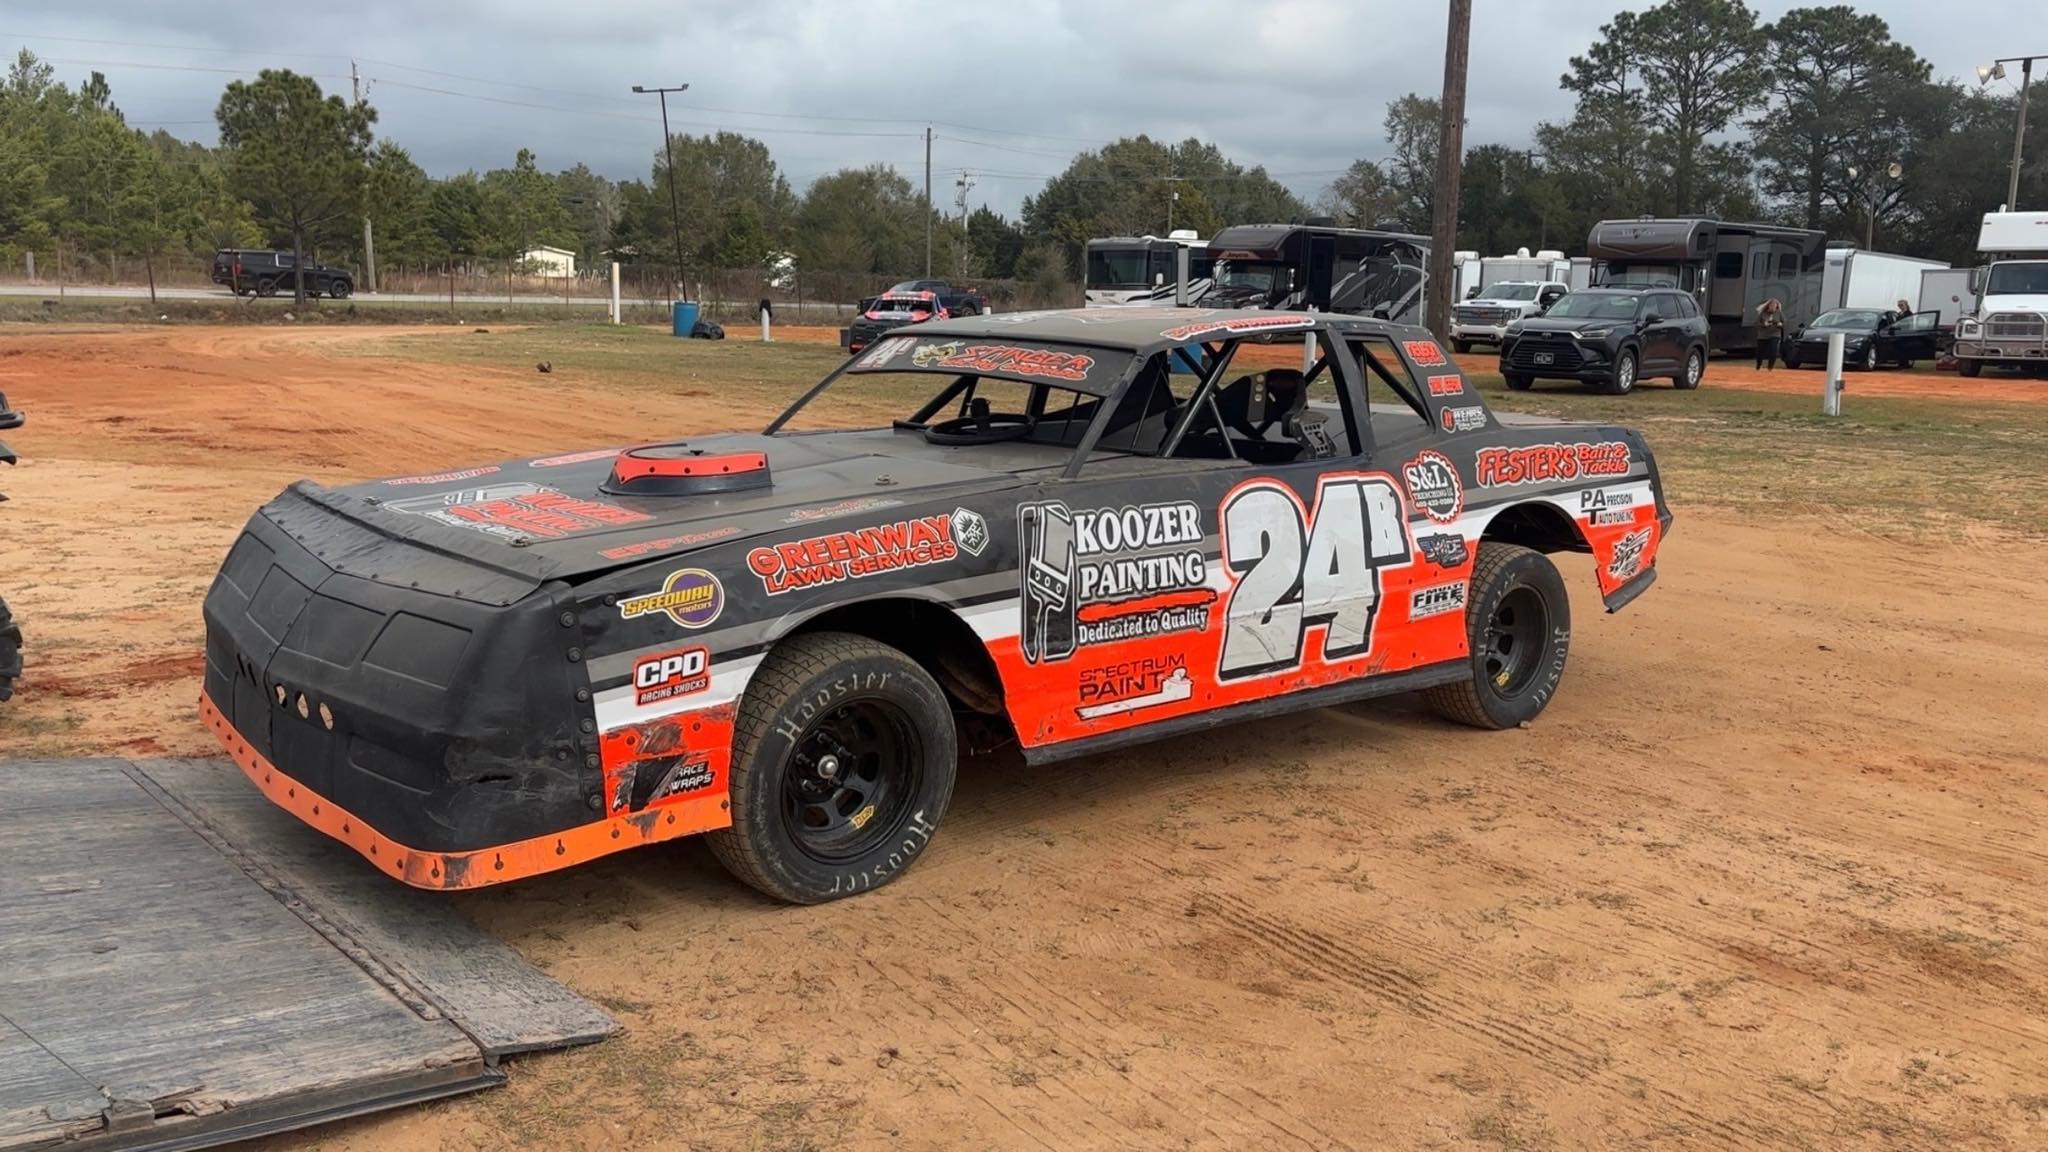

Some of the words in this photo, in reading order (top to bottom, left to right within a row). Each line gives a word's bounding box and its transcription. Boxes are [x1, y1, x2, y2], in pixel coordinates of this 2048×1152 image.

[1406, 464, 1449, 491] S&L
[1478, 446, 1577, 484] FESTER'S
[1577, 446, 1611, 459] Bait
[1612, 444, 1627, 458] &
[1582, 459, 1627, 474] Tackle
[1607, 494, 1633, 505] PRECISION
[749, 514, 951, 576] GREENWAY
[1074, 504, 1202, 554] KOOZER
[766, 562, 843, 594] LAWN
[849, 542, 957, 575] SERVICES
[1079, 552, 1204, 599] PAINTING
[624, 584, 715, 616] SPEEDWAY
[679, 601, 713, 614] motors
[1078, 616, 1143, 644] Dedicated
[1146, 615, 1158, 633] to
[1161, 608, 1208, 631] Quality
[637, 650, 706, 688] CPD
[1080, 653, 1185, 682] SPECTRUM
[640, 687, 673, 704] RACING
[673, 677, 707, 695] SHOCKS
[1080, 670, 1166, 701] PAINT
[777, 671, 893, 748] Hoosier
[671, 773, 713, 791] WRAPS
[829, 808, 937, 895] Hoosier
